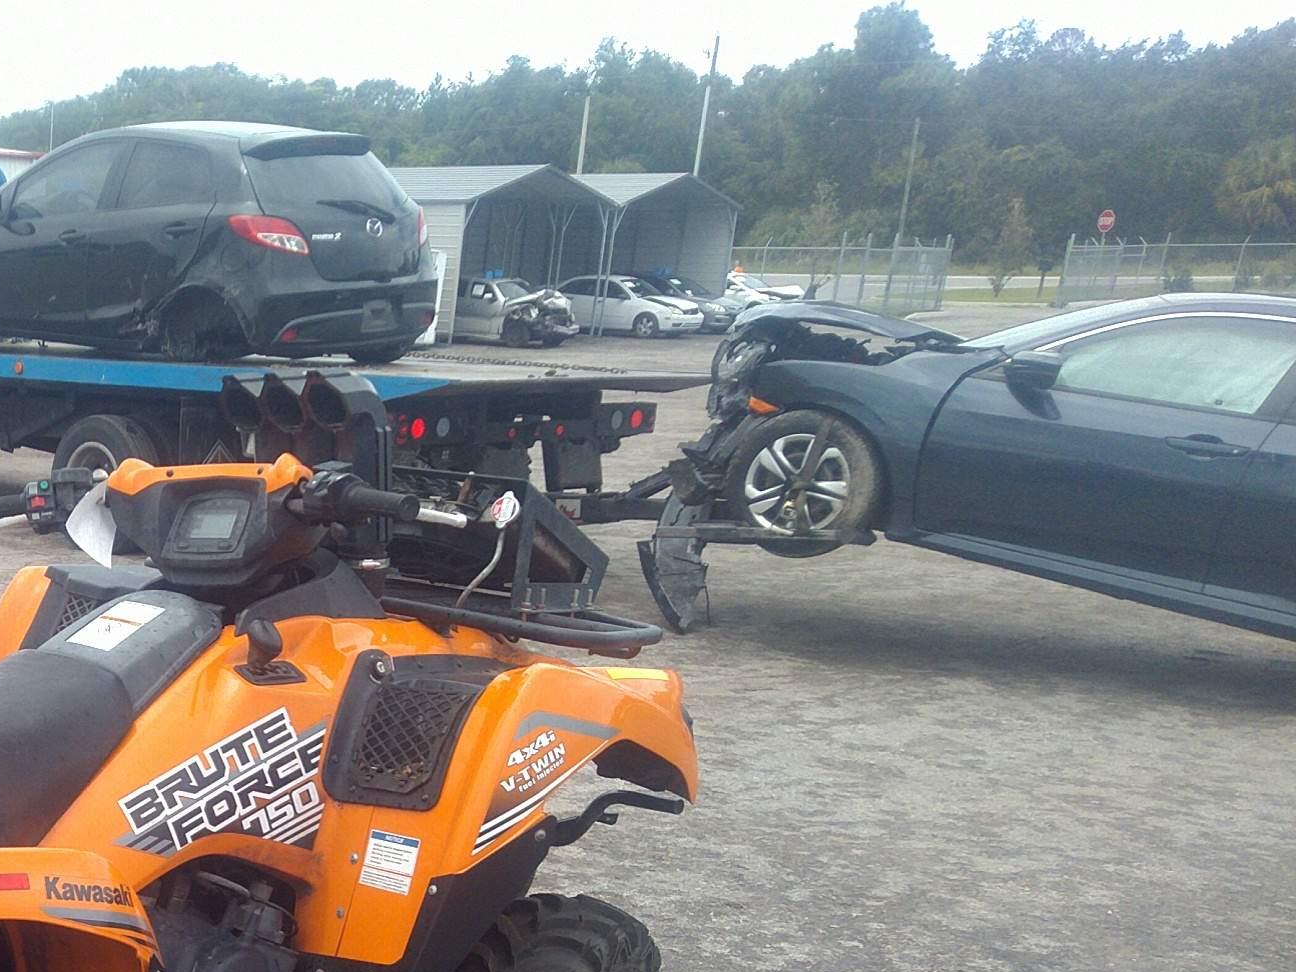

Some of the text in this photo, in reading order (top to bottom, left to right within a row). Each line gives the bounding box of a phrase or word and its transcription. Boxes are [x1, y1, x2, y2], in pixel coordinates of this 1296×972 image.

[121, 709, 296, 832] BRUTE
[168, 732, 325, 848] FORCE
[500, 743, 566, 792] V-TWIN
[241, 781, 320, 834] 750
[44, 876, 134, 908] Kawasaki
